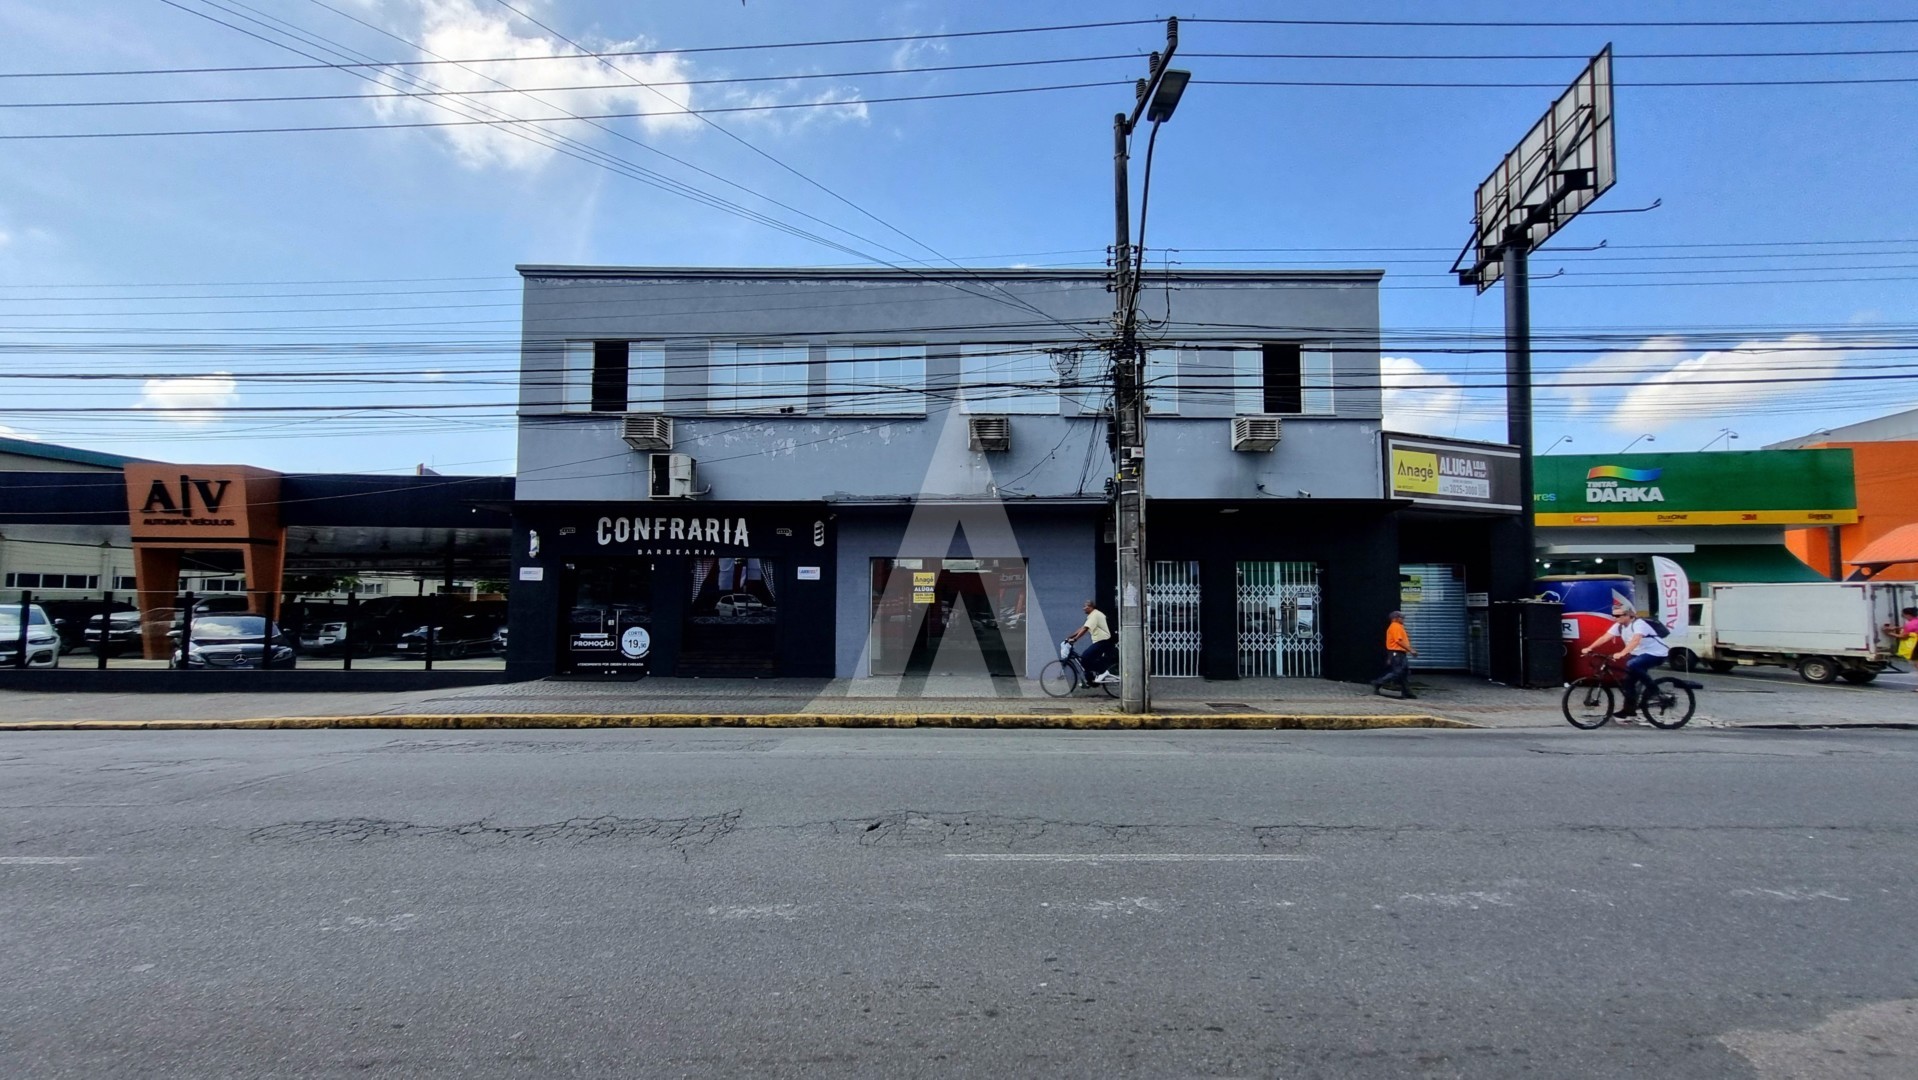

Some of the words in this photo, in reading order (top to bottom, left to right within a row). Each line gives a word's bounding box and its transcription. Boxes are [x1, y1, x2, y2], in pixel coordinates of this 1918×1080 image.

[1439, 456, 1473, 477] ALUGA
[1586, 487, 1665, 502] DARKA
[596, 516, 749, 547] CONFRARIA
[1663, 573, 1678, 630] ALESSI
[573, 640, 615, 648] PROMOÇÃO
